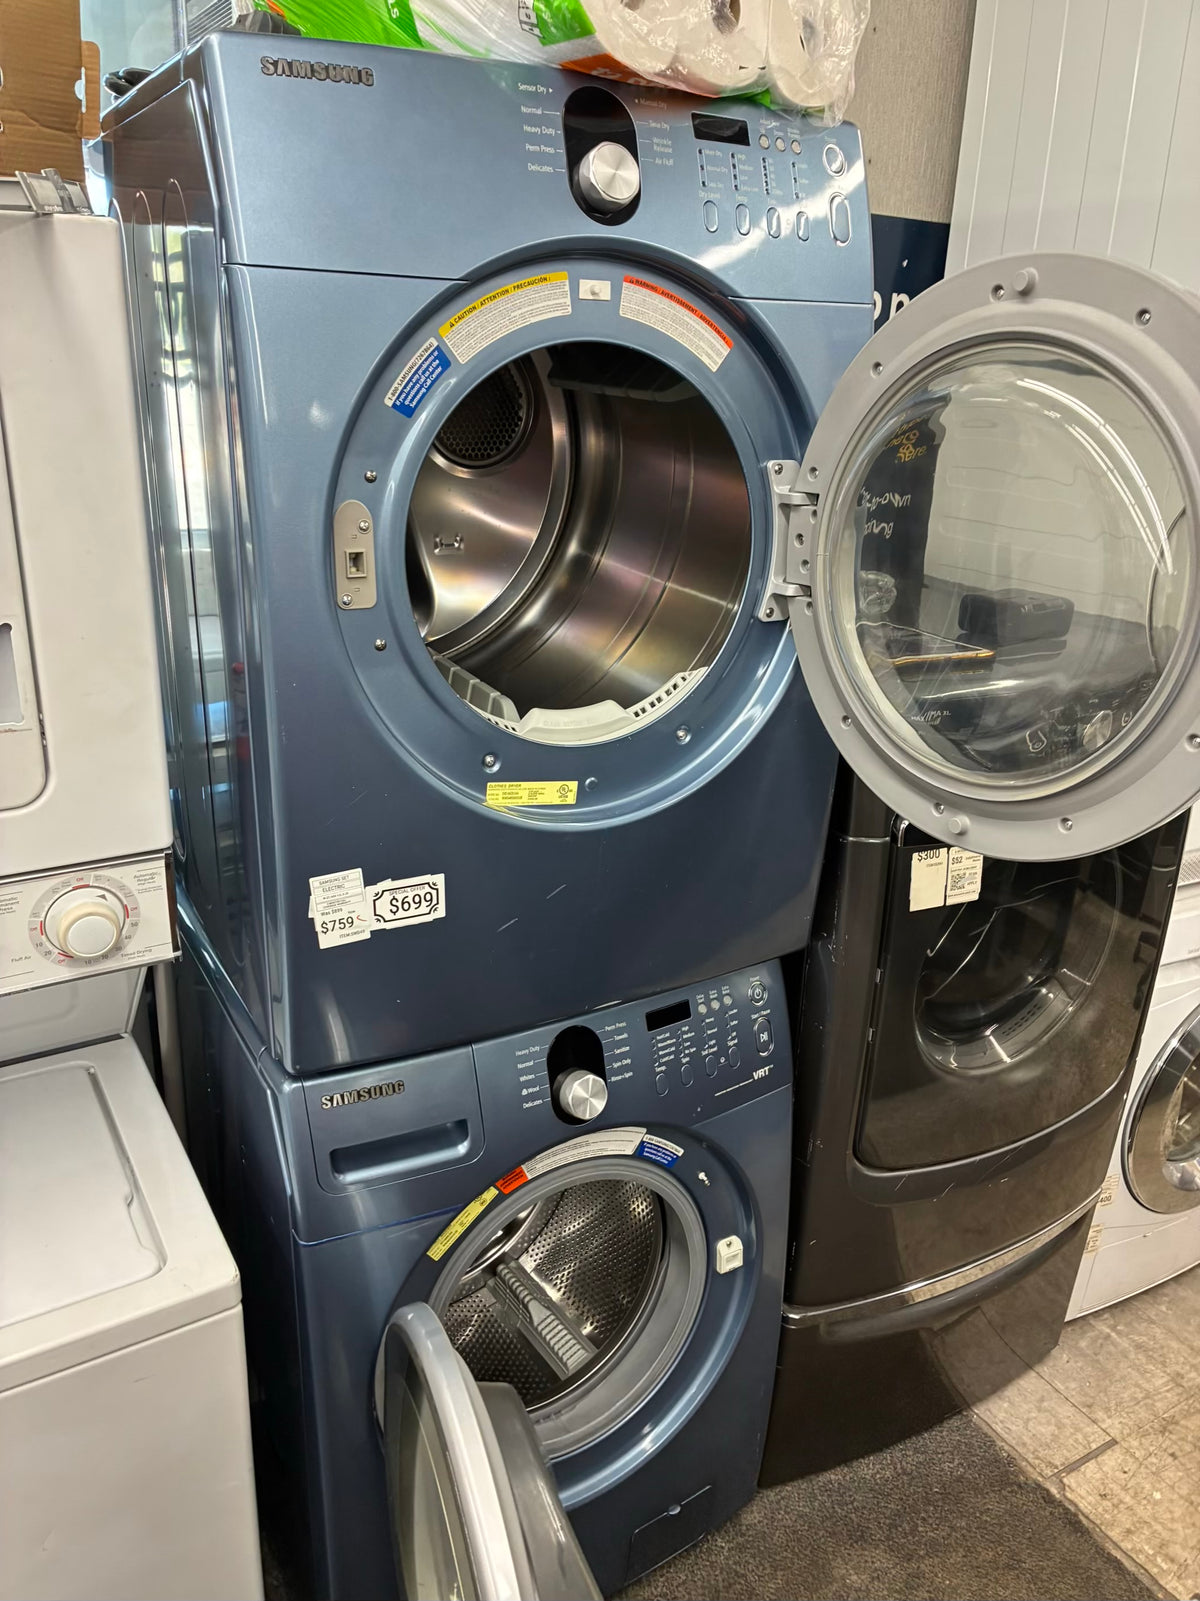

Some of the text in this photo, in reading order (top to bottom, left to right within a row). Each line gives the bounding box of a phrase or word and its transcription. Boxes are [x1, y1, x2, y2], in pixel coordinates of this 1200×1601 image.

[260, 56, 375, 87] SAMSUNG
[518, 83, 547, 94] Sensor Dry
[521, 105, 543, 114] Normal
[523, 125, 556, 136] Heavy Duty
[525, 144, 555, 153] Perm Press
[527, 163, 554, 173] Delicates
[454, 304, 478, 324] CAUTION
[480, 288, 510, 306] ATTENTION
[513, 276, 548, 292] PRECAUCIÓN
[418, 355, 435, 375] problems
[410, 387, 427, 408] Samsung
[429, 366, 443, 381] Center
[404, 383, 421, 405] questions
[917, 848, 941, 862] $300
[319, 876, 342, 886] SAMSUNG
[322, 883, 346, 893] ELECTRIC
[388, 885, 426, 896] SPECIAL OFFER
[389, 891, 433, 916] $699
[320, 915, 355, 935] $759
[515, 1046, 540, 1057] Heavy Duty
[517, 1060, 534, 1069] Normal
[321, 1080, 405, 1110] SAMSUNG
[528, 1086, 540, 1094] Wool
[523, 1099, 543, 1109] Delicates
